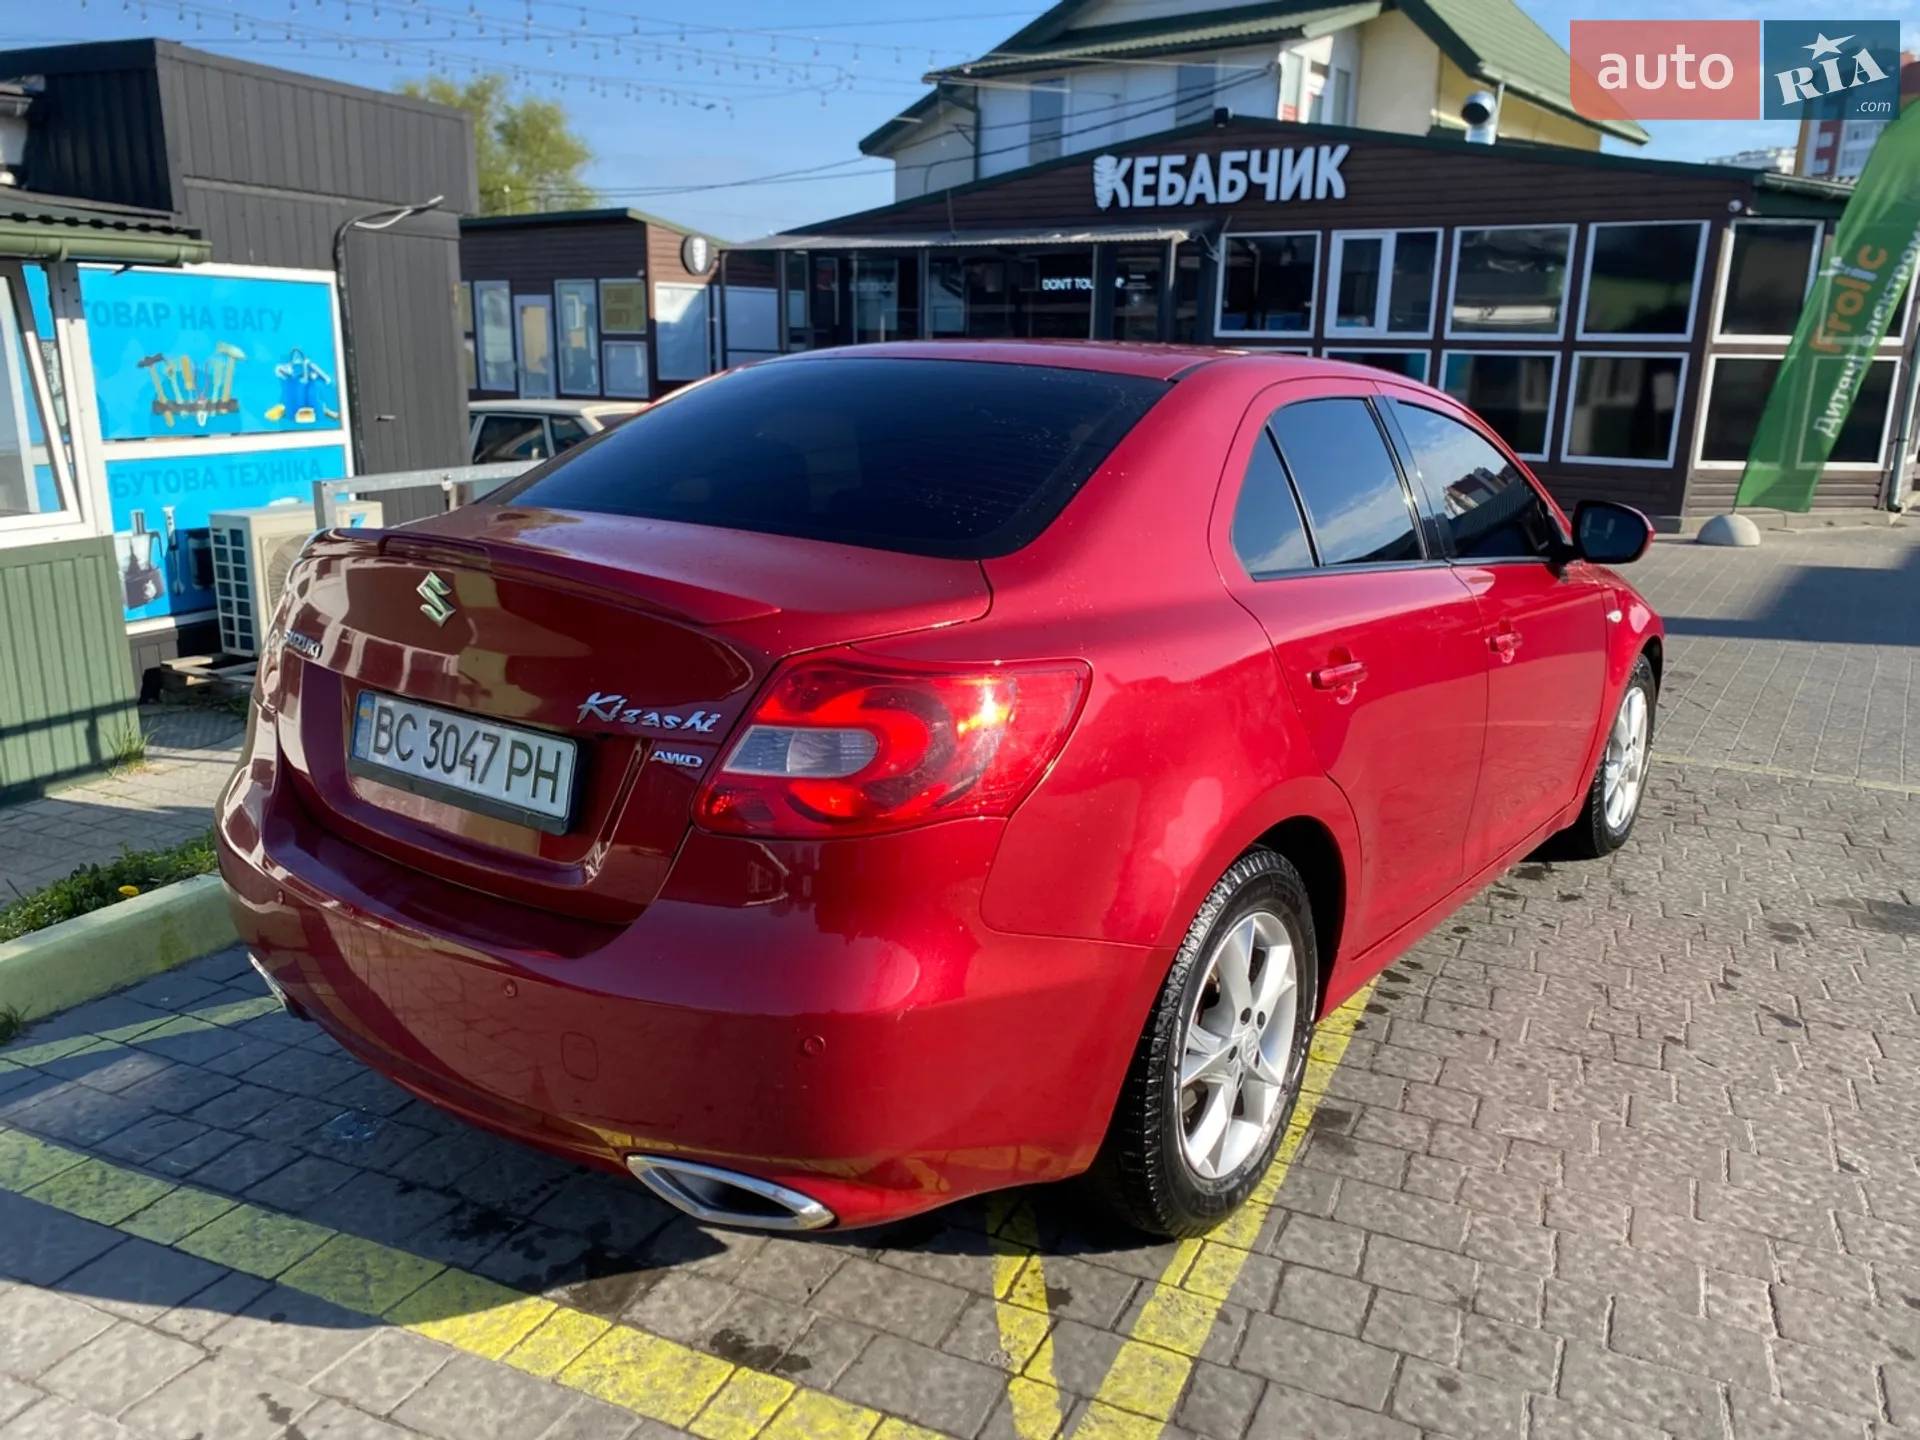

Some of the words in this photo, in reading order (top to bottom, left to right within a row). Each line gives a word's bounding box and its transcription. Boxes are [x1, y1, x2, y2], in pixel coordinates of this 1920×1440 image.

[1094, 144, 1349, 210] КЕБАБЧИК
[86, 301, 171, 329] ОВАР
[178, 304, 216, 331] НА
[222, 306, 284, 333] ВАГУ
[1810, 244, 1888, 353] Frolic
[110, 465, 219, 498] БУТОВА
[222, 458, 323, 489] ТЕХНІКА
[284, 629, 322, 658] SUZUKI
[576, 692, 721, 733] Kizashi
[372, 706, 417, 762] BC
[423, 720, 500, 784] 3047
[505, 740, 562, 803] PH
[650, 750, 703, 768] AWD
